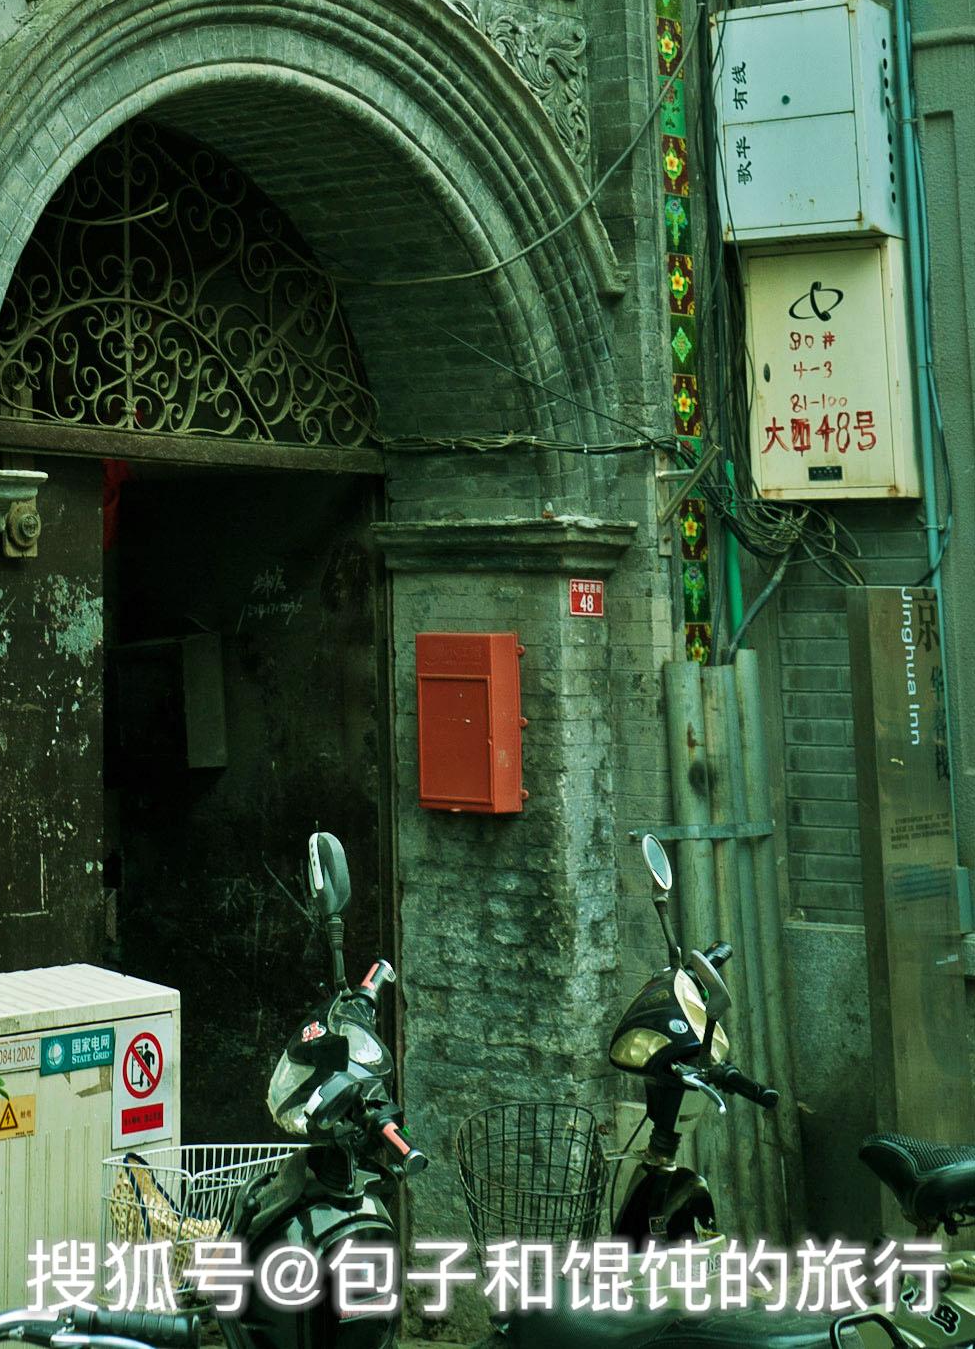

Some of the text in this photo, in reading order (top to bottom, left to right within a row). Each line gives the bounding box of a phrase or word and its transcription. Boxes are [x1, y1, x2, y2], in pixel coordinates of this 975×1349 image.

[580, 594, 594, 612] 48
[901, 586, 920, 745] Jinghua Inn
[71, 1034, 110, 1055] 国家电网
[71, 1050, 110, 1065] STATE GRID
